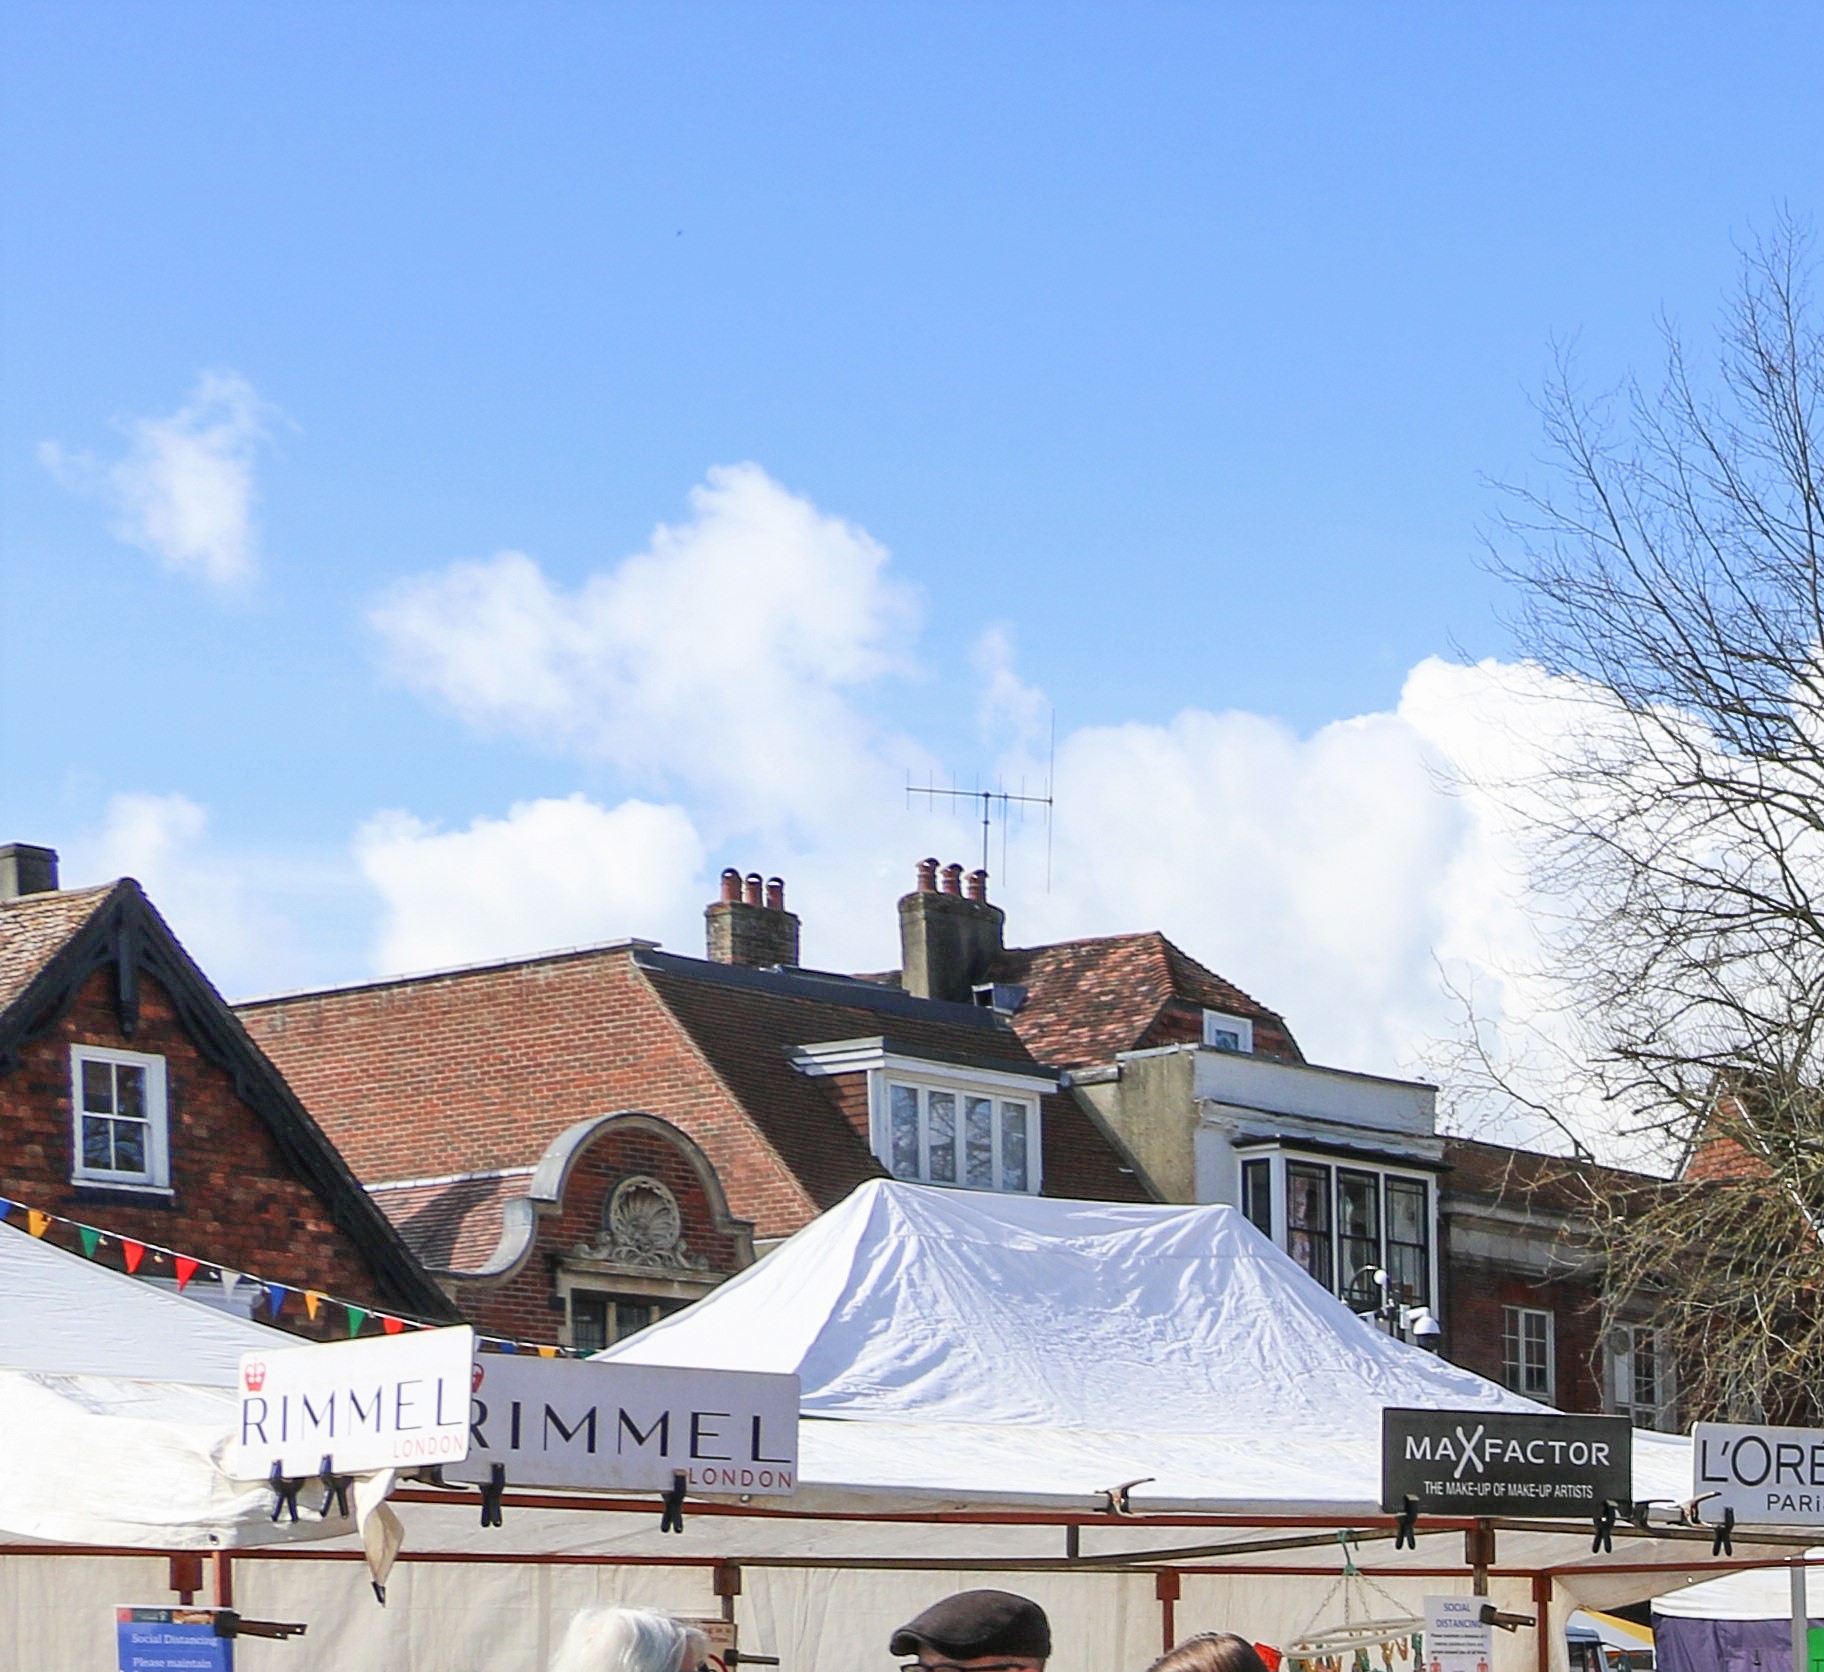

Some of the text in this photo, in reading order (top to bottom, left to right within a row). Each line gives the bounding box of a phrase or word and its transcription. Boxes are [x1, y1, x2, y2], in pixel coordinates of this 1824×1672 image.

[241, 1377, 464, 1447] RIMMEL
[470, 1398, 792, 1465] RIMMEL
[393, 1437, 465, 1460] LONDON
[688, 1466, 793, 1489] LONDON
[1424, 1480, 1594, 1499] THE MAKE-UP OF MAKE-UP ARTISTS
[1443, 1602, 1471, 1612] SOCIAL
[131, 1634, 219, 1647] Social Distancing
[132, 1657, 212, 1669] Please maintain
